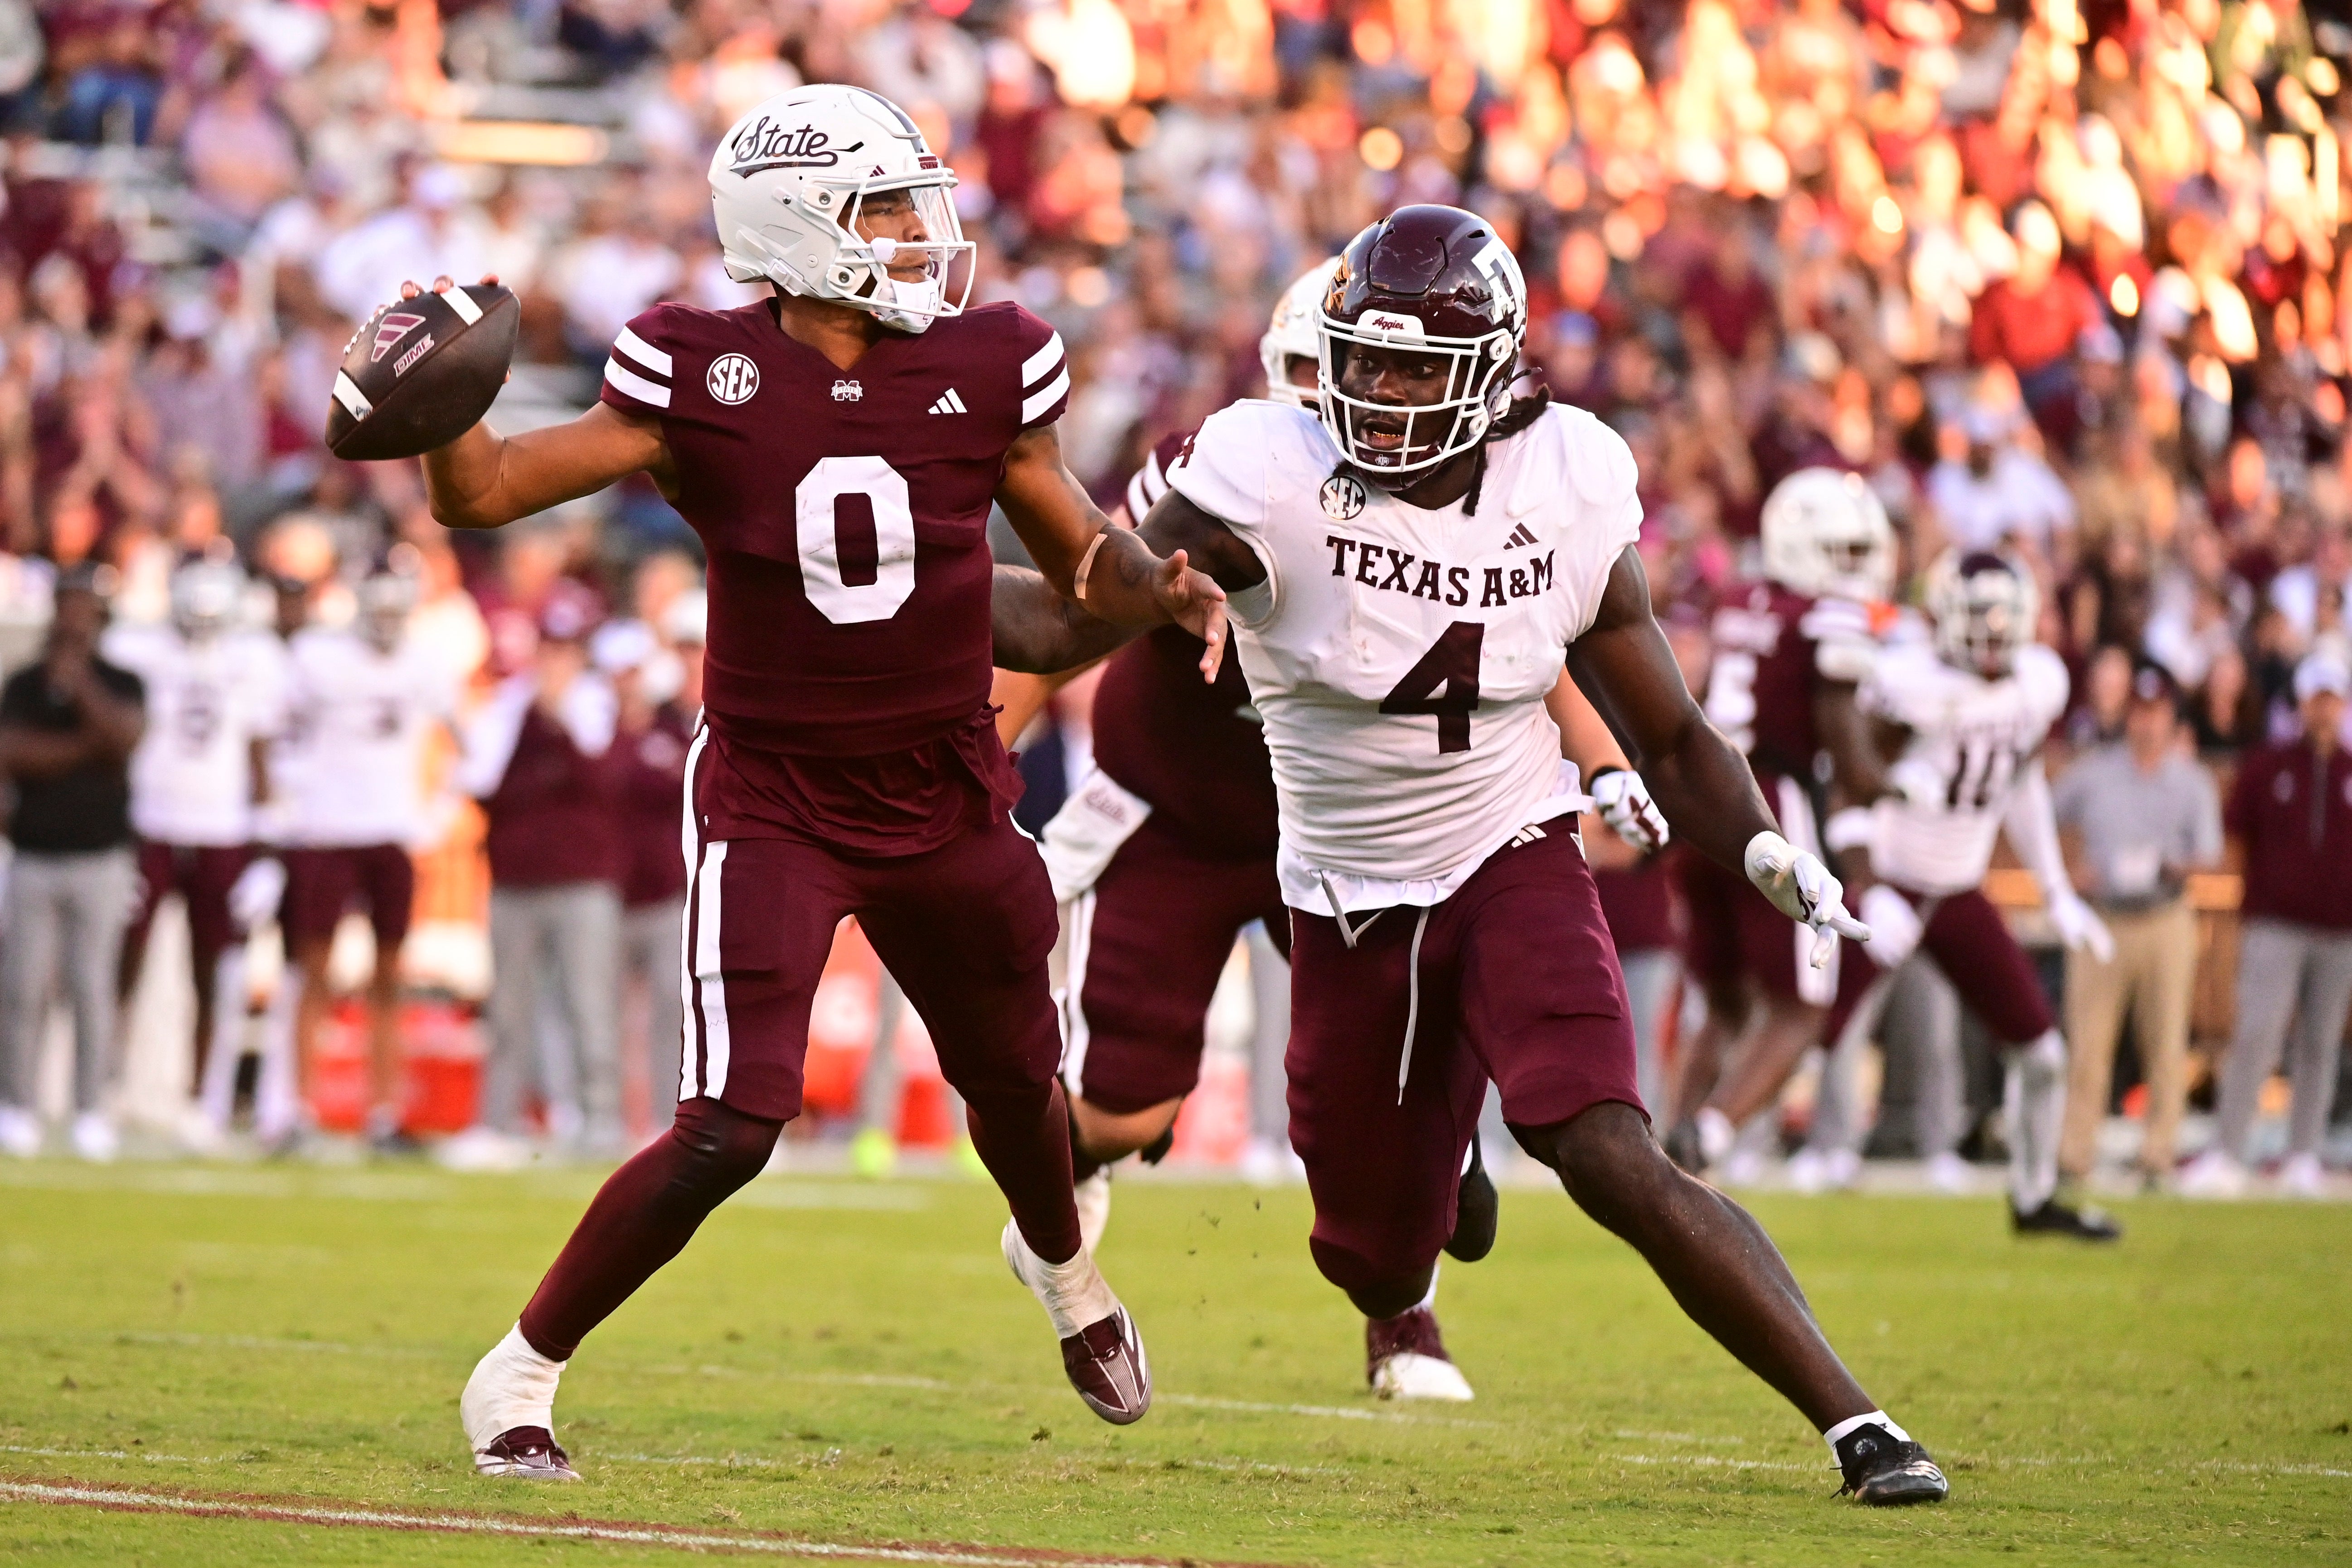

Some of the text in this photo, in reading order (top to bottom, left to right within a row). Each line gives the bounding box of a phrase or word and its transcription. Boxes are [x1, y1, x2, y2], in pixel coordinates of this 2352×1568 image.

[729, 116, 836, 169] State
[1372, 316, 1405, 330] Aggies
[711, 357, 755, 401] SEC
[1322, 477, 1363, 518] SEC
[795, 455, 915, 624] 0
[1327, 536, 1555, 608] TEXAS A&M
[1379, 621, 1484, 754] 4
